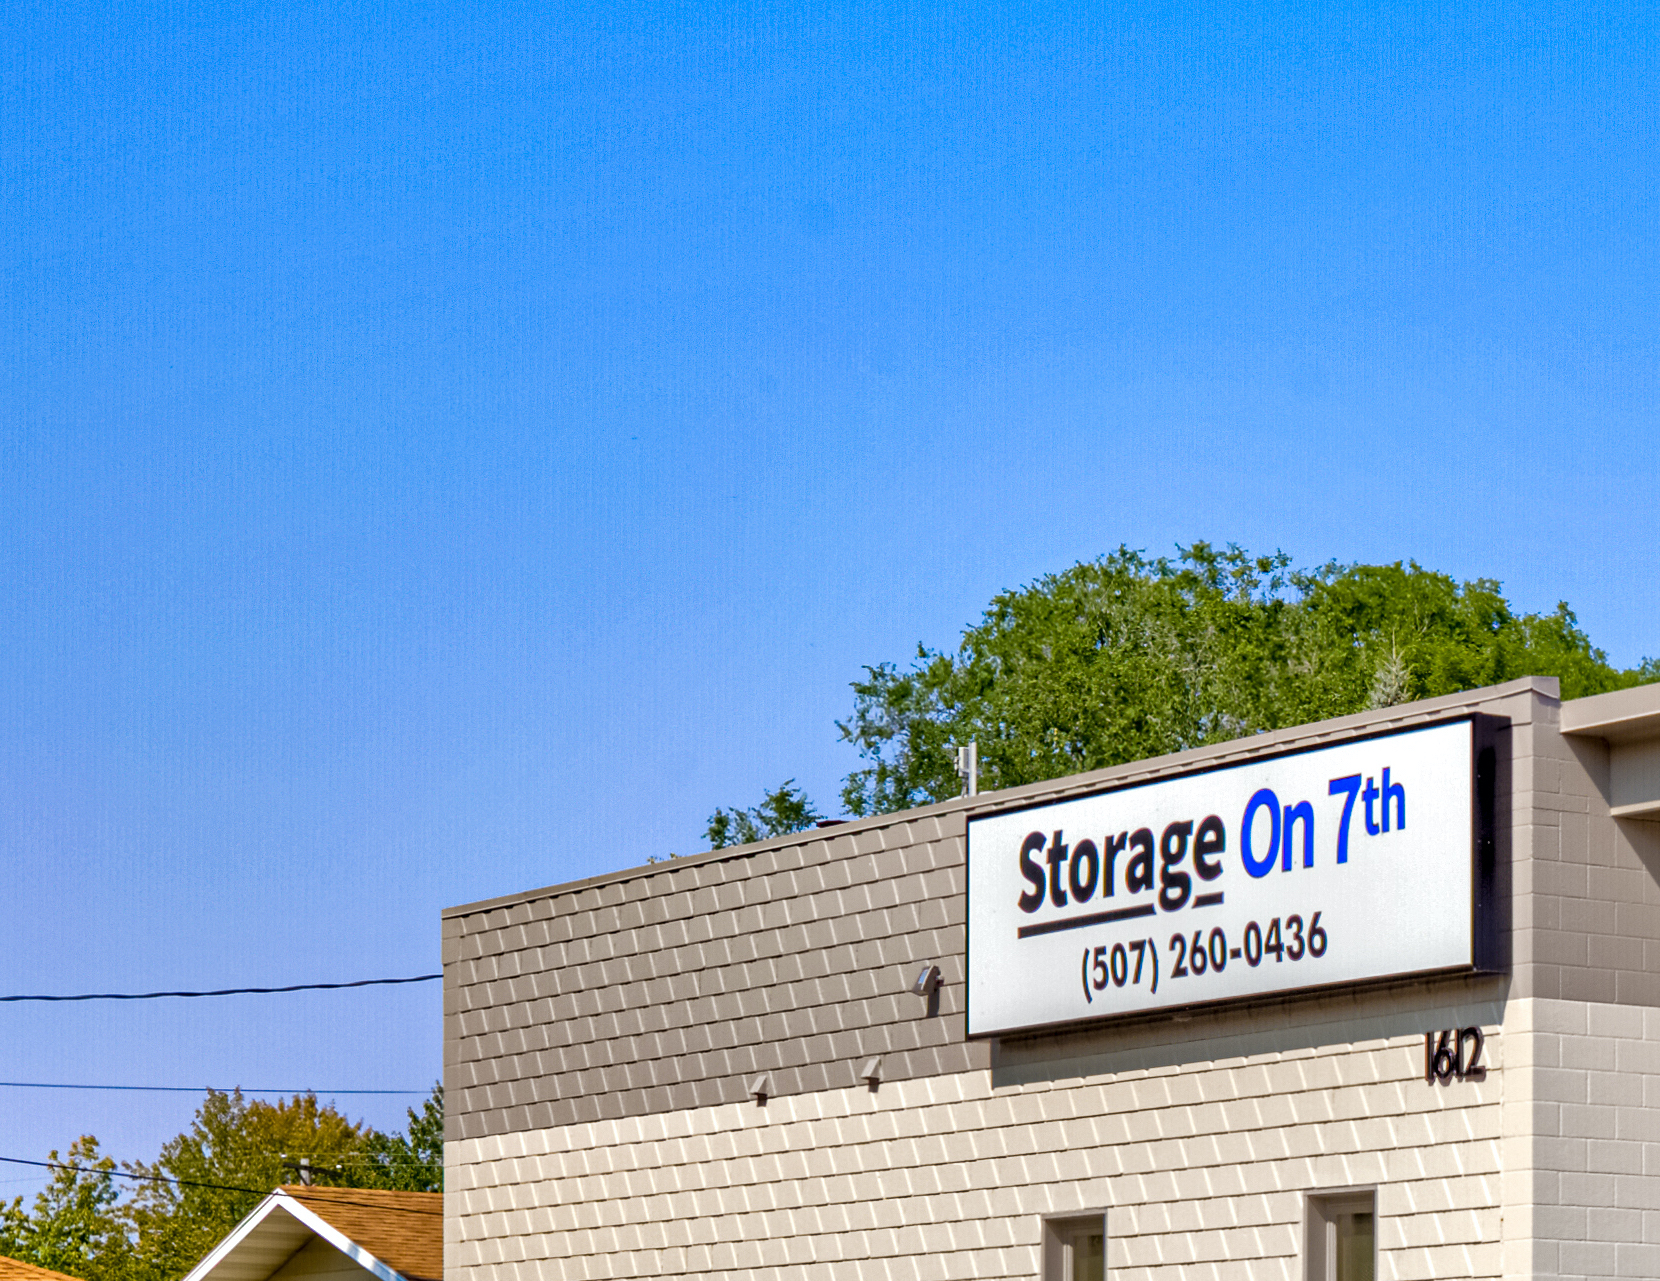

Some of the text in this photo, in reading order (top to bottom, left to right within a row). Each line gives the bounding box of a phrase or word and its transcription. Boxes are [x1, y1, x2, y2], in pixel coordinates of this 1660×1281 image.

[1017, 766, 1406, 913] Storage On 7th
[1081, 911, 1328, 1004] (507) 260-0436
[1424, 1027, 1484, 1081] 1612
